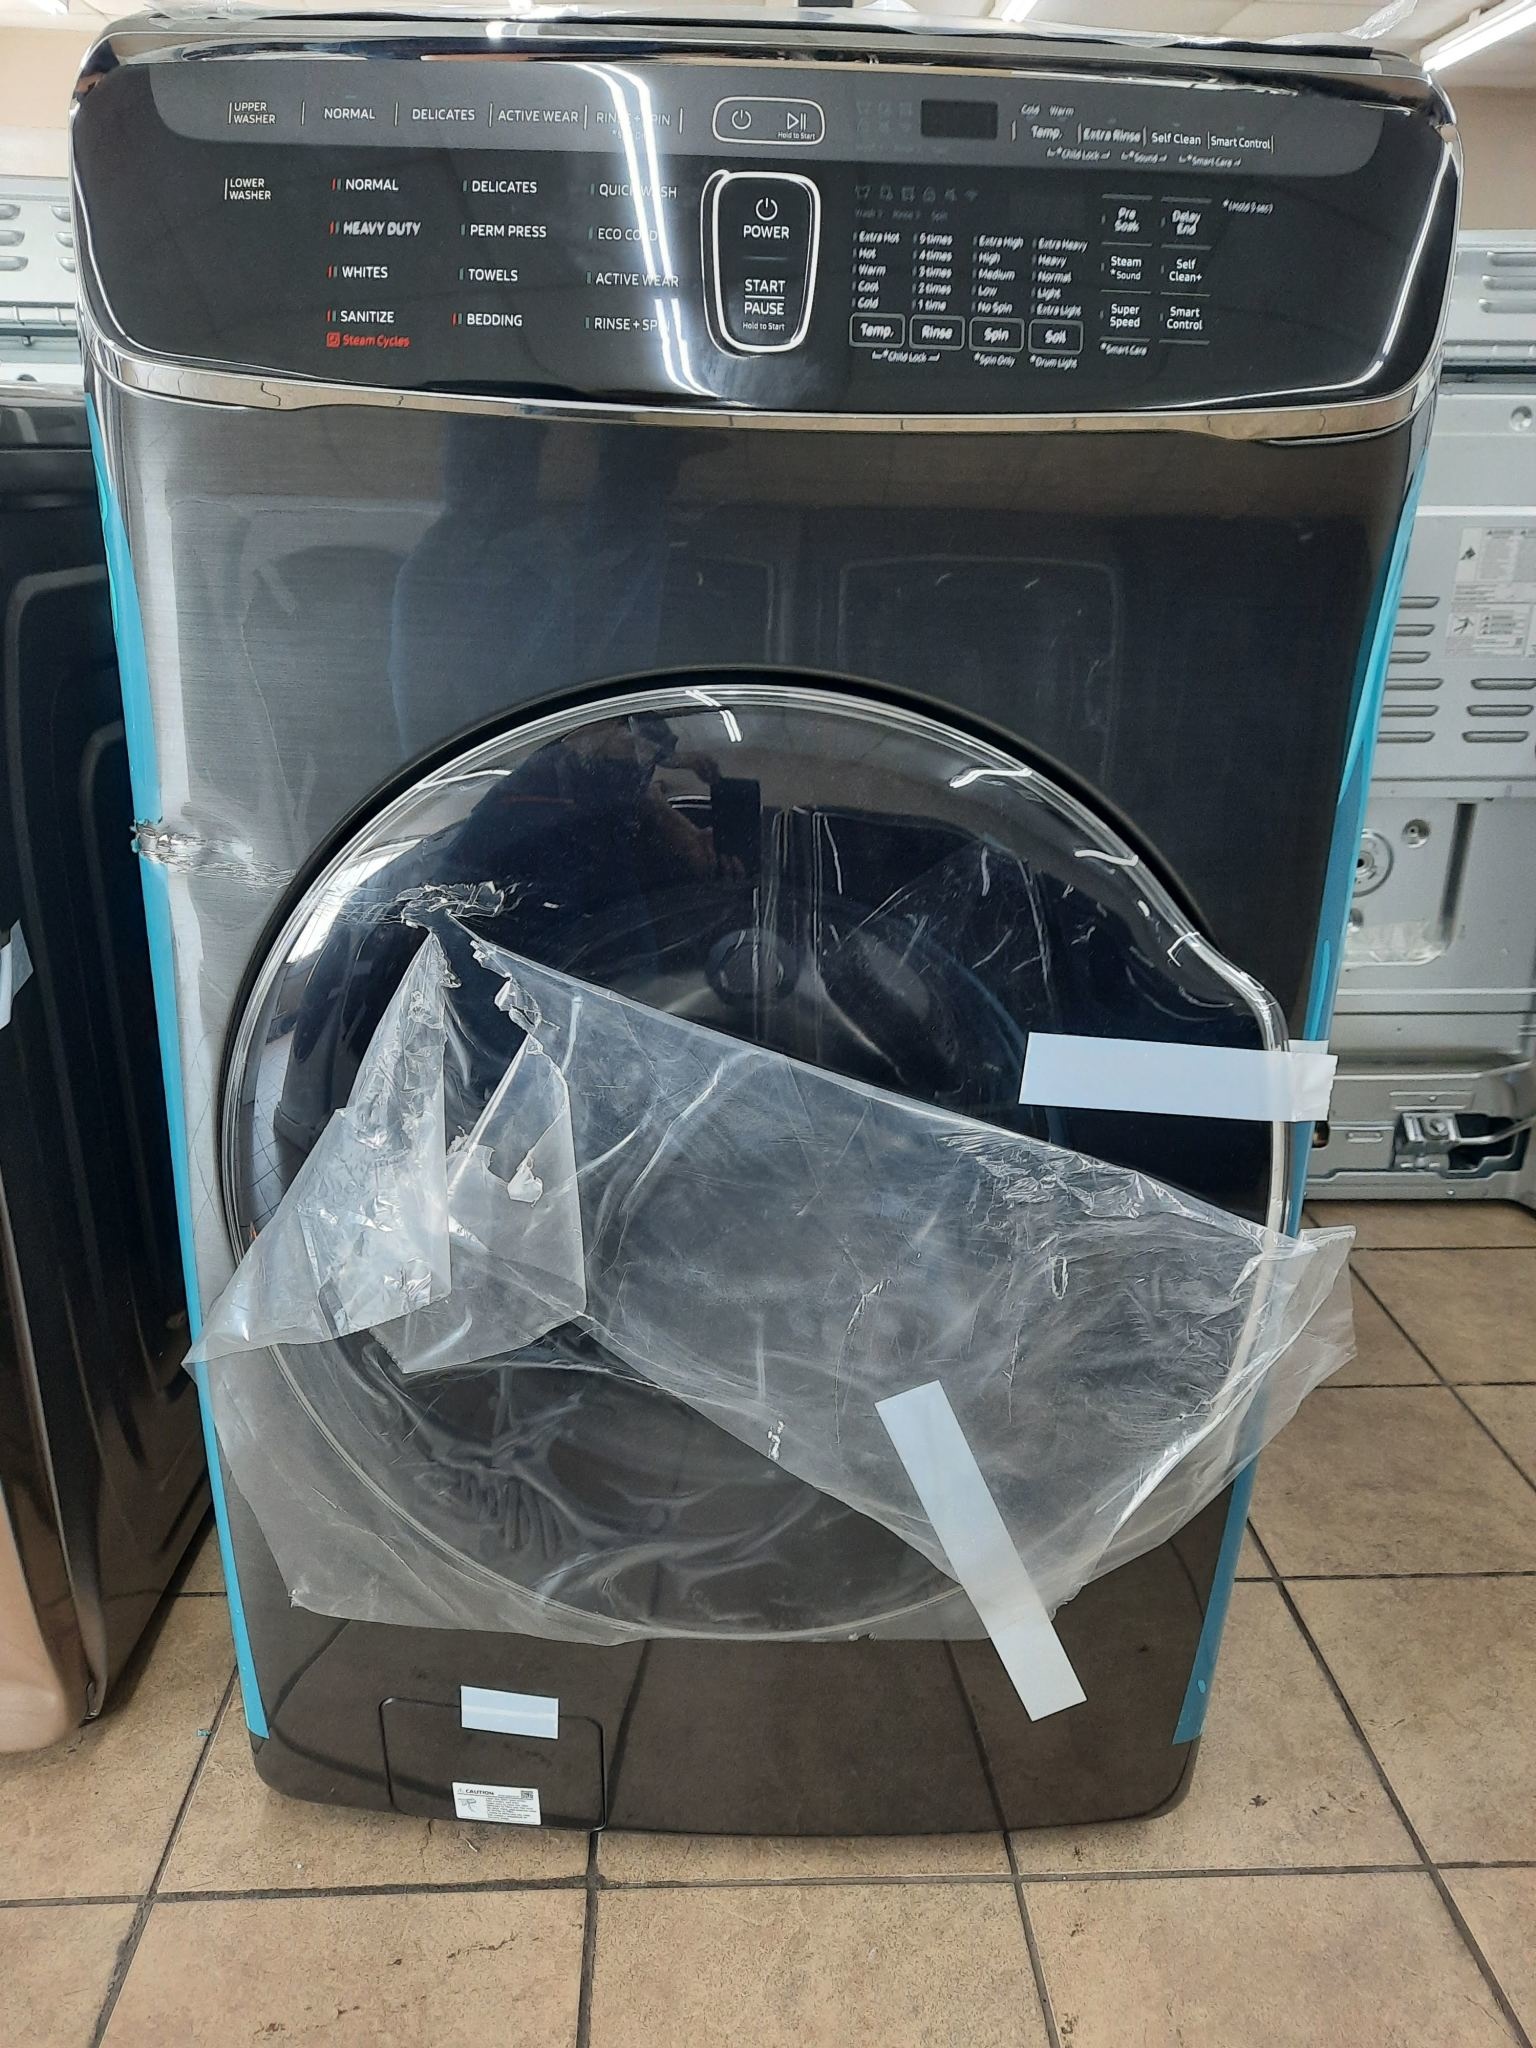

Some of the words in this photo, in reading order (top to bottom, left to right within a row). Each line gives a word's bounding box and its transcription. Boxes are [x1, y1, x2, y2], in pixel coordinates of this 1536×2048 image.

[234, 102, 267, 112] UPPER
[233, 114, 276, 124] WASHER
[324, 108, 376, 120] NORMAL
[412, 109, 475, 121] DELICATES
[498, 110, 540, 122] ACTIVE
[543, 111, 579, 123] WEAR
[596, 111, 632, 124] RIN
[641, 113, 671, 126] PIN
[801, 132, 815, 140] Start
[1151, 132, 1171, 143] Self
[1173, 133, 1201, 145] Clean
[1211, 136, 1237, 147] Smart
[1238, 137, 1271, 149] Control
[230, 178, 265, 188] LOWER
[345, 179, 399, 191] NORMAL
[471, 180, 537, 193] DELICATES
[229, 190, 272, 200] WASHER
[640, 185, 677, 198] WSH
[343, 221, 385, 236] HEAVY
[387, 221, 421, 236] DUTY
[470, 224, 505, 237] PERM
[508, 225, 547, 238] PRESS
[598, 228, 622, 240] ECO
[625, 229, 659, 241] COD
[743, 225, 790, 239] POWER
[1111, 256, 1142, 267] Steam
[1176, 259, 1196, 270] Self
[342, 266, 389, 279] WHITES
[468, 268, 518, 282] TOWELS
[1116, 271, 1141, 281] Sound
[1169, 271, 1202, 283] Clean+
[596, 273, 639, 286] ACTIVE
[642, 274, 679, 288] WEAR
[745, 280, 786, 293] START
[744, 302, 785, 316] PAUSE
[1111, 304, 1140, 316] Super
[1170, 306, 1200, 318] Smart
[340, 310, 395, 323] SANITIZE
[466, 313, 523, 327] BEDDING
[1110, 317, 1141, 329] Speed
[594, 317, 631, 330] RINSE
[633, 321, 640, 329] +
[742, 321, 759, 330] Hold
[760, 322, 767, 330] to
[768, 321, 785, 331] Start
[1166, 318, 1203, 330] Control
[343, 335, 375, 346] Steam
[376, 335, 411, 348] Cycles
